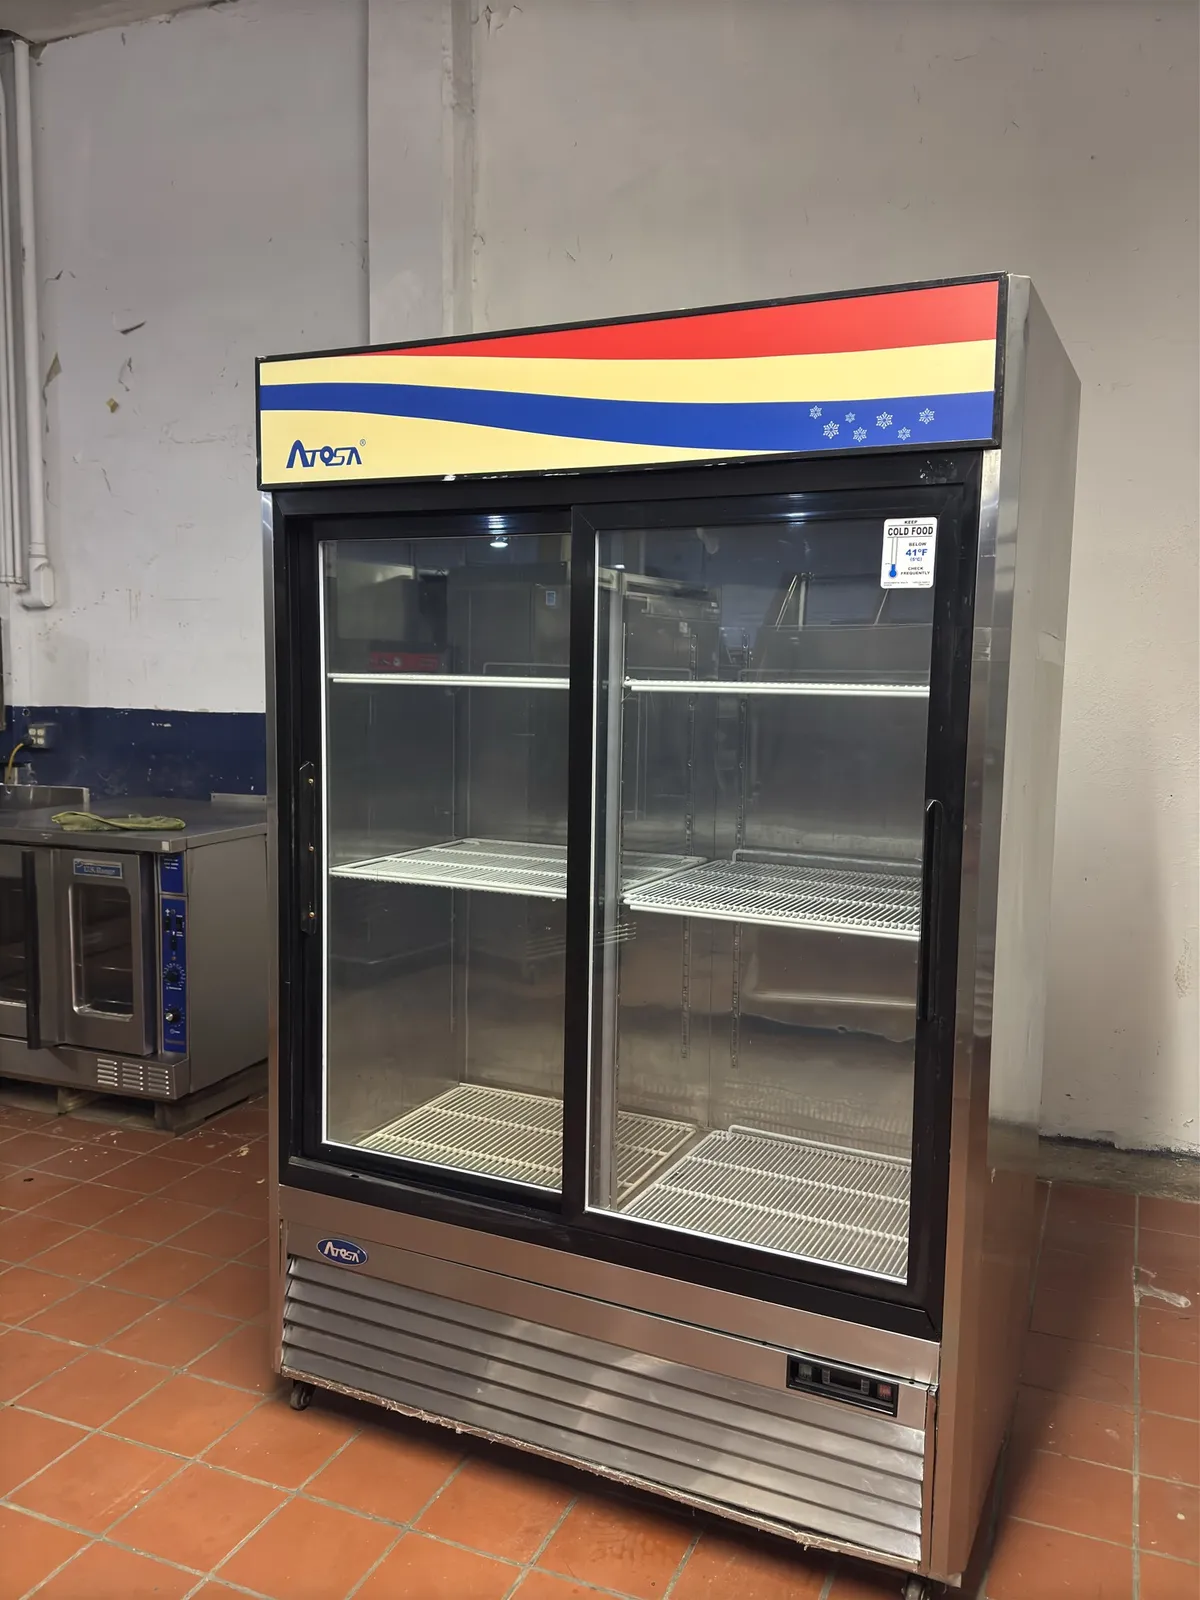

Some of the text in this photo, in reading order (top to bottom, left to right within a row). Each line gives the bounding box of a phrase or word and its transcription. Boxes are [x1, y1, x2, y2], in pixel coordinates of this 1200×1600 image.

[888, 526, 934, 536] COLD FOOD
[905, 548, 928, 556] 41°F
